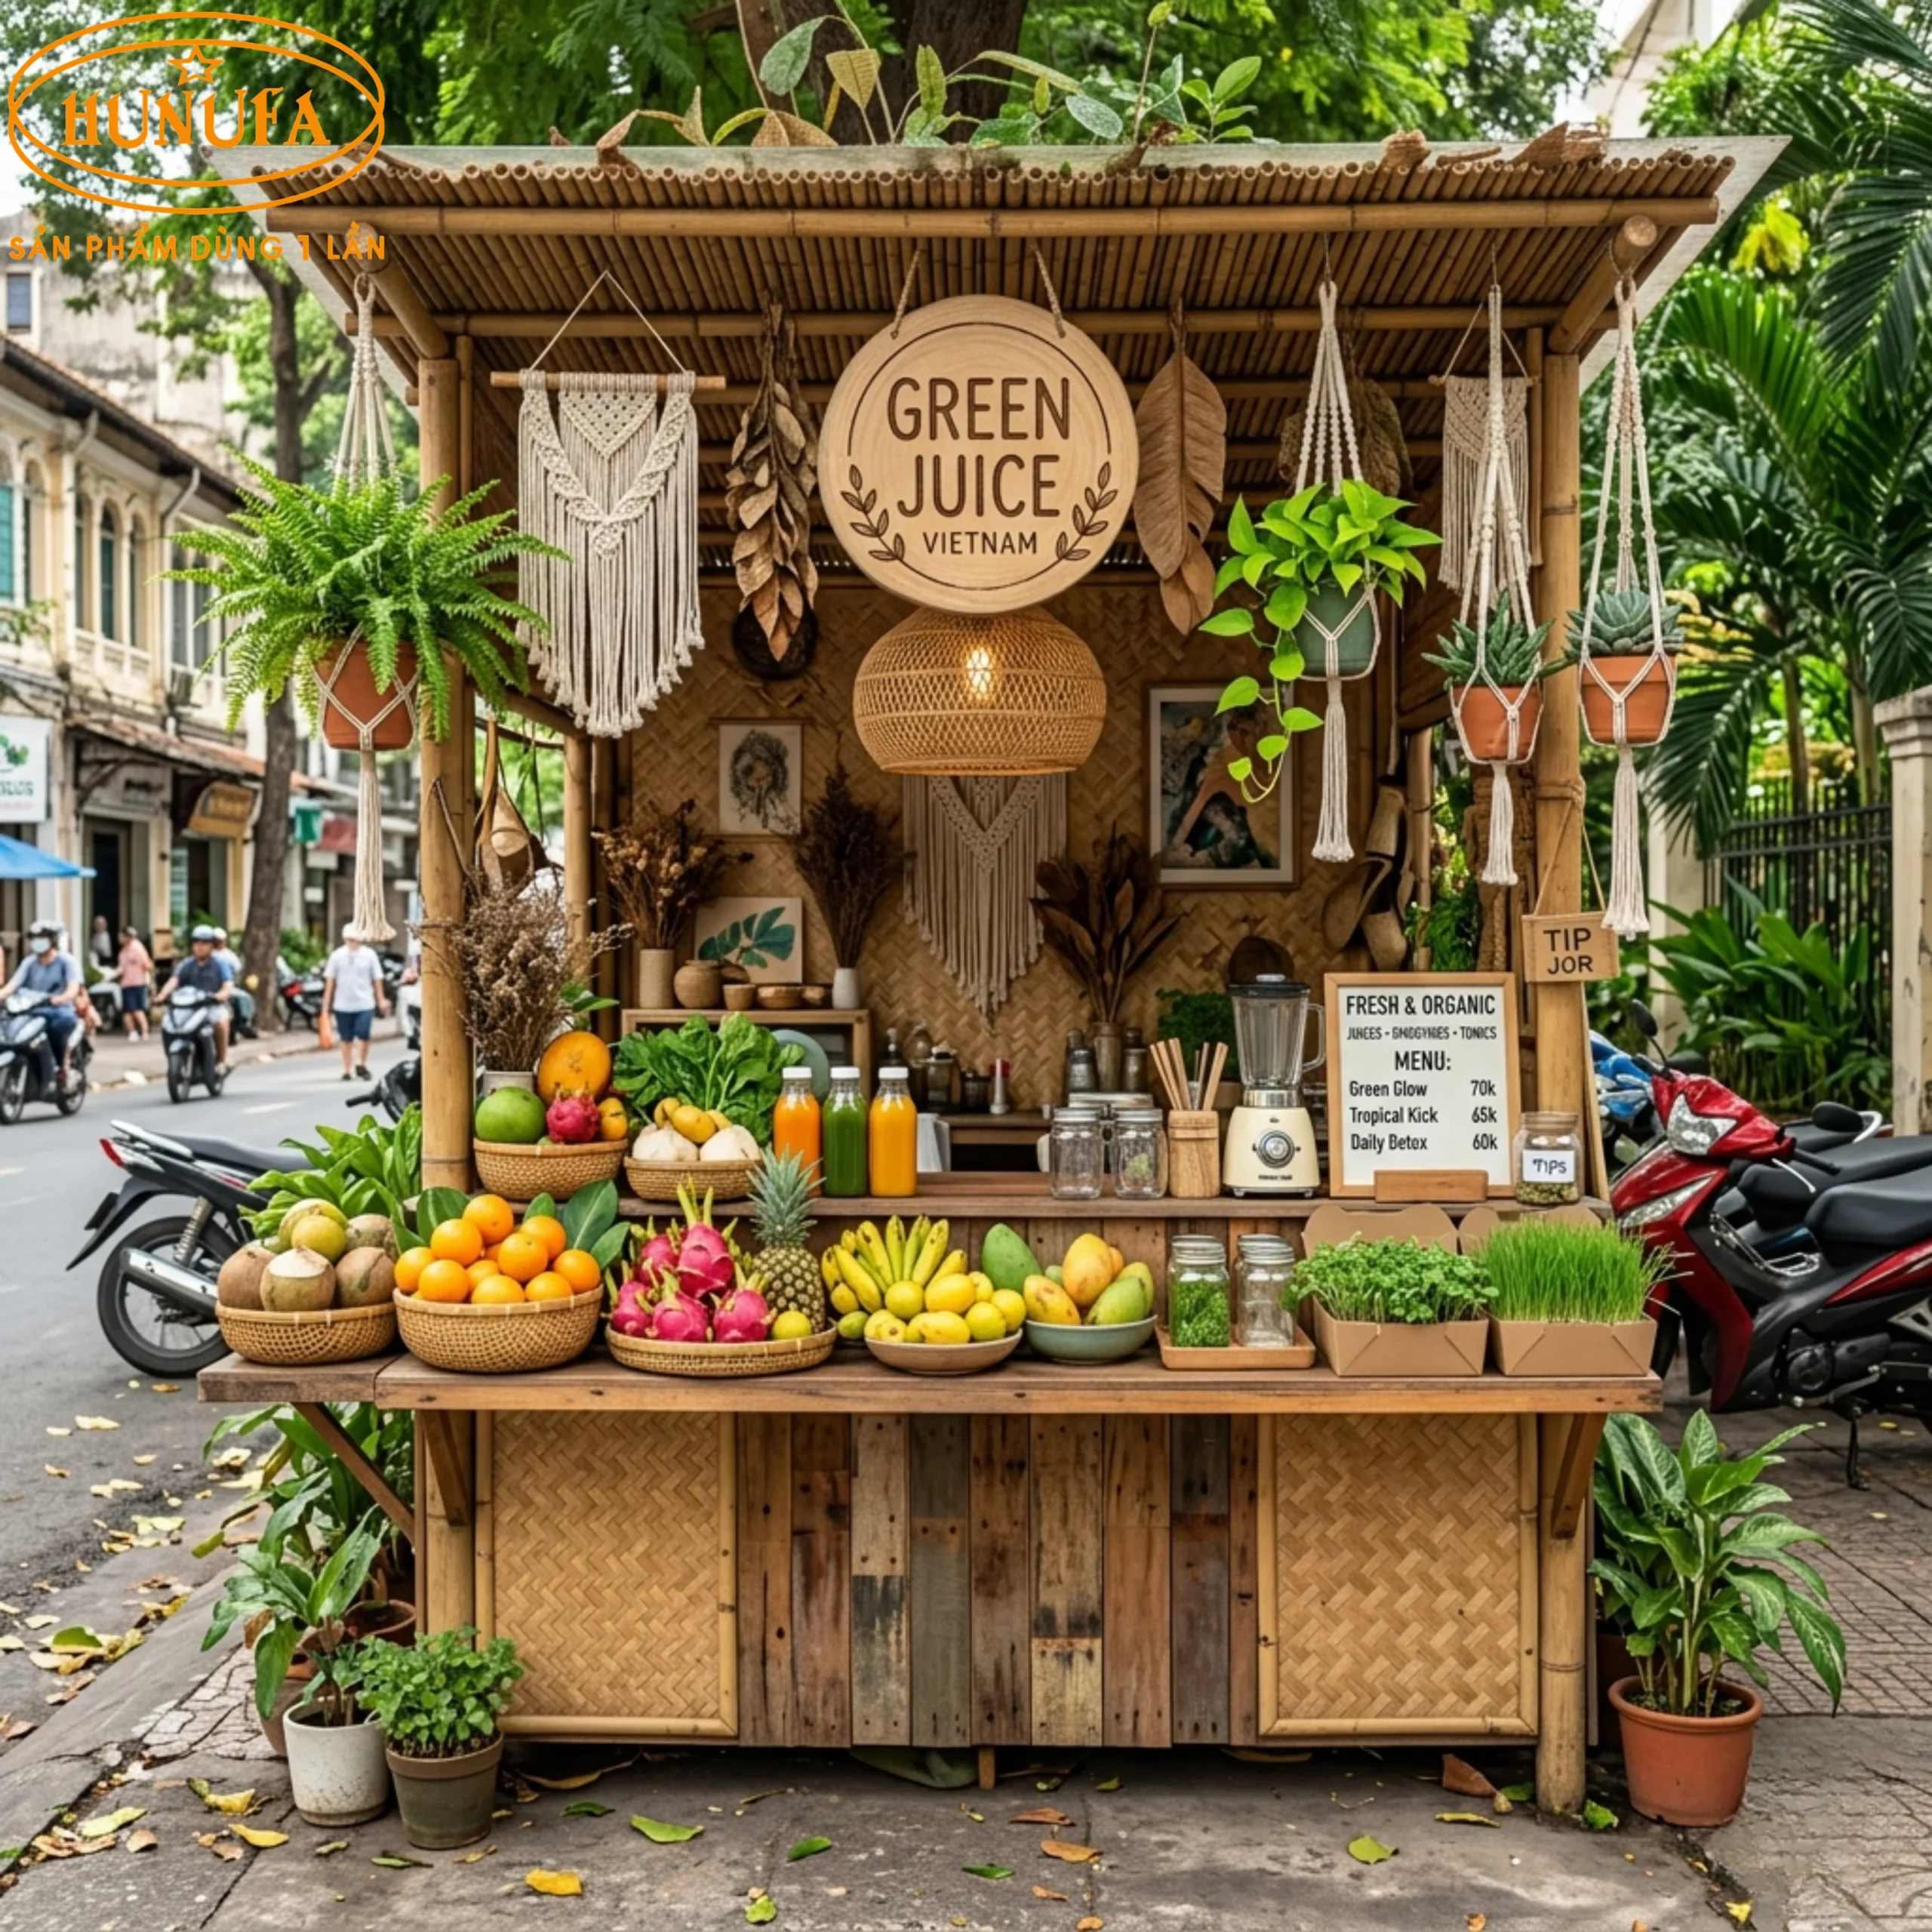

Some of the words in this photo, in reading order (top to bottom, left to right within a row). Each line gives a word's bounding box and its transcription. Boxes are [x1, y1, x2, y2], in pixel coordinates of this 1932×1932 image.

[887, 377, 1070, 441] GREEN
[897, 454, 1060, 518] JUICE
[922, 531, 1037, 555] VIETNAM
[1543, 927, 1592, 952] TIP
[1547, 955, 1593, 975] JOR
[1346, 995, 1399, 1015] FRESH
[1404, 995, 1417, 1015] &
[1422, 994, 1495, 1015] ORGANIC
[1395, 1050, 1451, 1071] MENU:
[1349, 1080, 1389, 1097] Green
[1393, 1080, 1428, 1097] Glow
[1470, 1079, 1497, 1097] 70k
[1349, 1106, 1404, 1127] Tropical
[1407, 1106, 1438, 1124] Kick
[1471, 1106, 1497, 1124] 65k
[1351, 1133, 1386, 1155] Daily
[1472, 1133, 1498, 1150] 60k
[1532, 1158, 1567, 1175] TIPS
